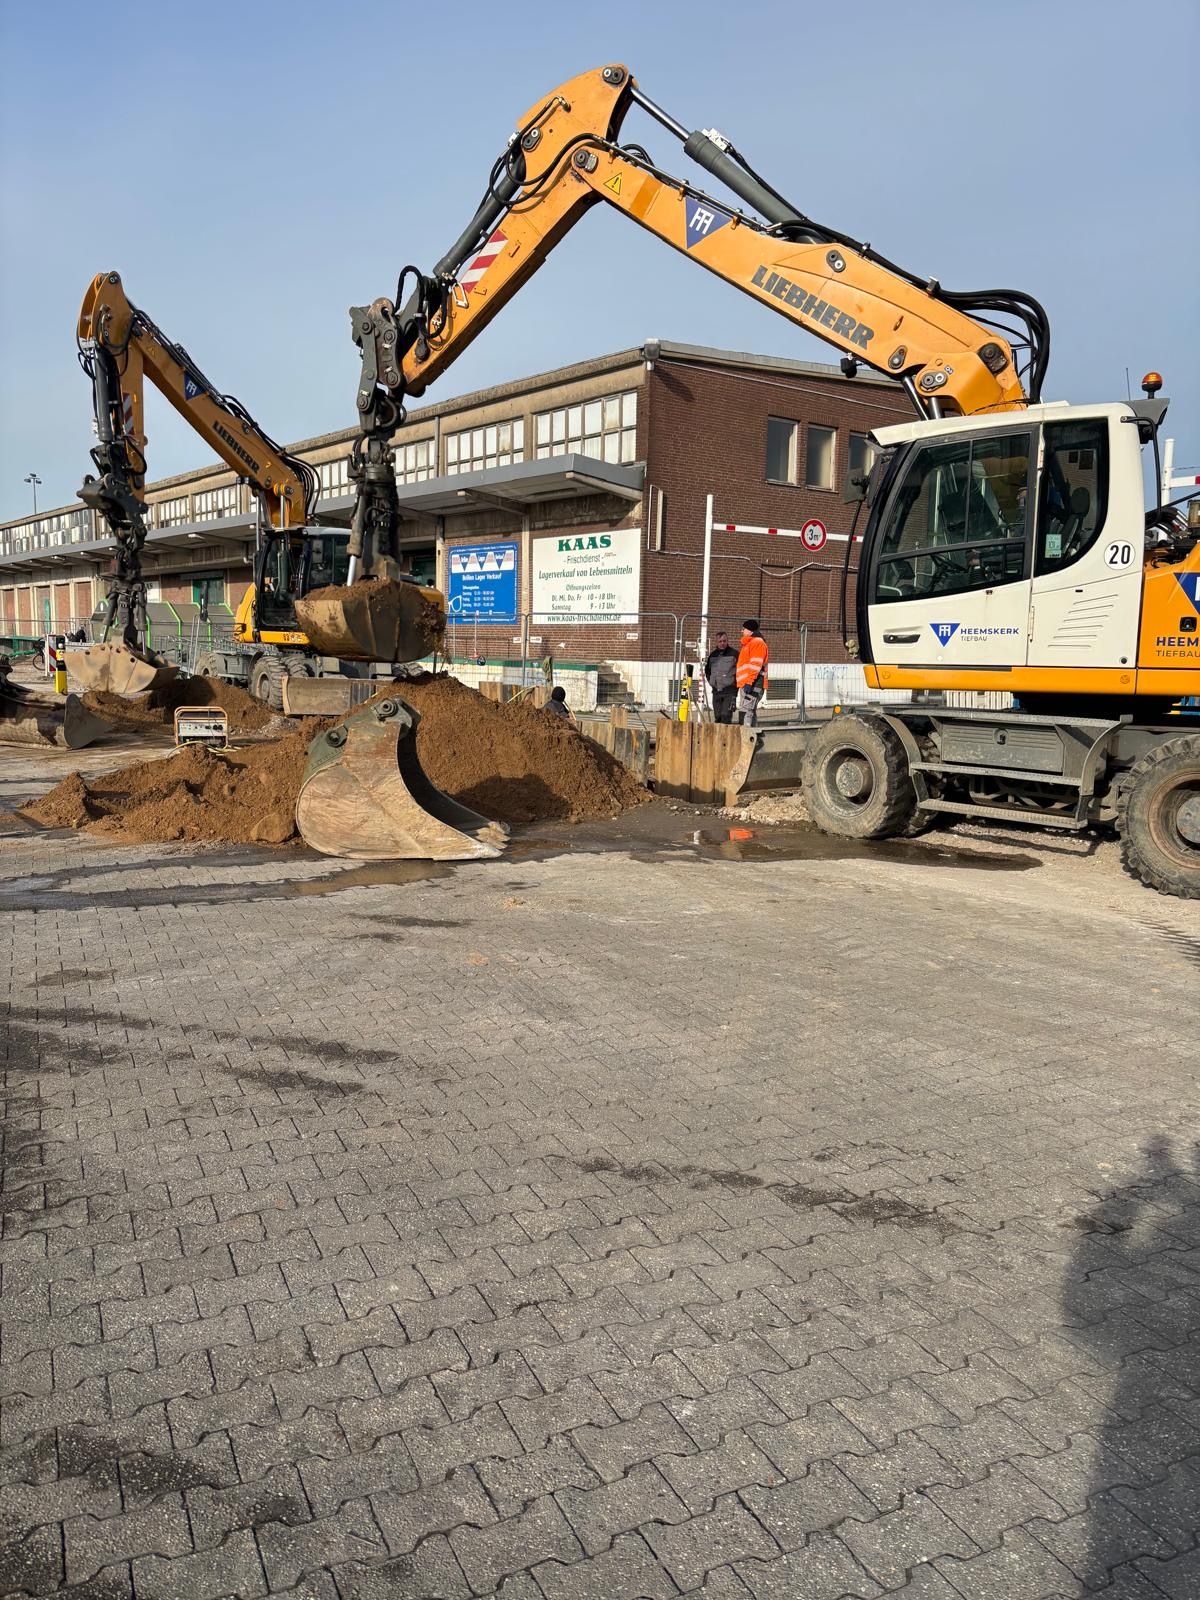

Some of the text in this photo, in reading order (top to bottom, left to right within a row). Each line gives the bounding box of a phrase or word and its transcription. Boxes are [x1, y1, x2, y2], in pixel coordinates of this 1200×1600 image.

[751, 265, 874, 350] LIEBHERR
[213, 421, 260, 473] LIEBHERR
[557, 535, 612, 552] KAAS
[1109, 544, 1131, 565] 20
[538, 564, 633, 580] Lagerverkauf von Lebensmitteln
[960, 627, 1019, 635] HEEMSKERK
